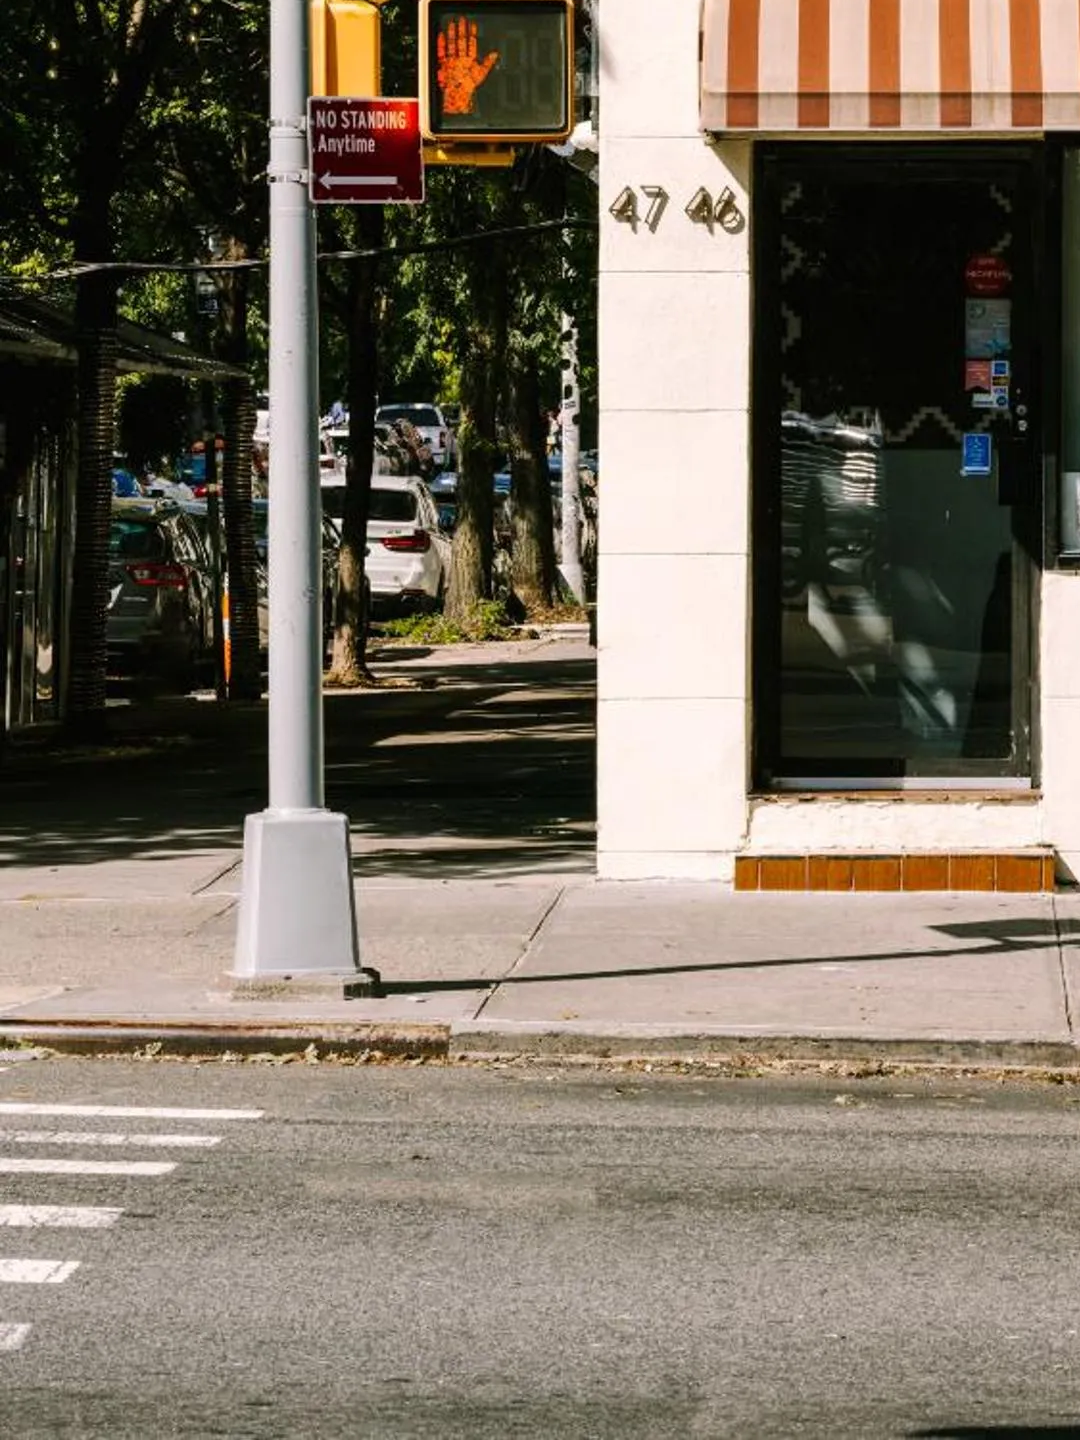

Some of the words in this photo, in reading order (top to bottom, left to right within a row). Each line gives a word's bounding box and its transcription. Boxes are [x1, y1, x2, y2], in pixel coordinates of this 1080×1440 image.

[315, 110, 337, 129] NO
[341, 110, 407, 130] STANDING
[318, 134, 376, 156] Anytime
[608, 185, 670, 235] 47
